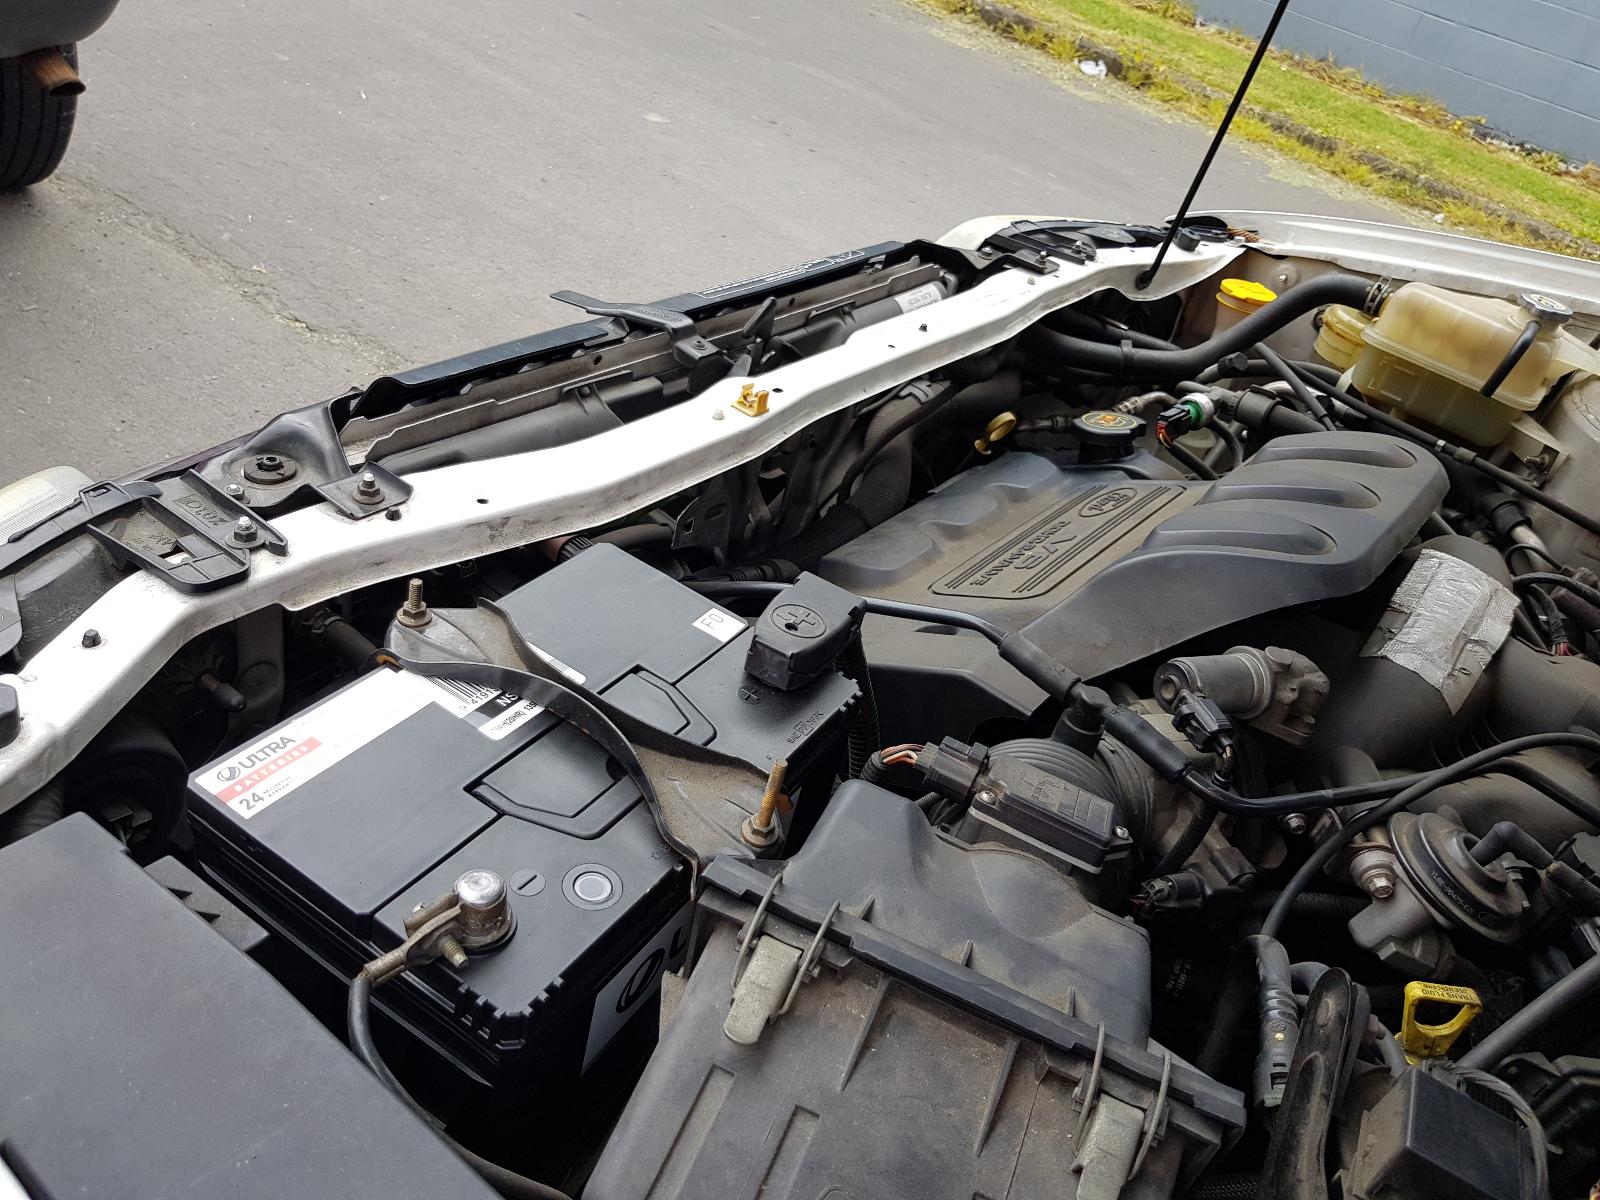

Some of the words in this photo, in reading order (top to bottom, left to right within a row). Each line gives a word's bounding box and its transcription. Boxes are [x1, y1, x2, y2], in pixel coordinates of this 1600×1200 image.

[1014, 535, 1077, 570] V6
[238, 736, 297, 769] ULTRA
[239, 792, 265, 811] 24
